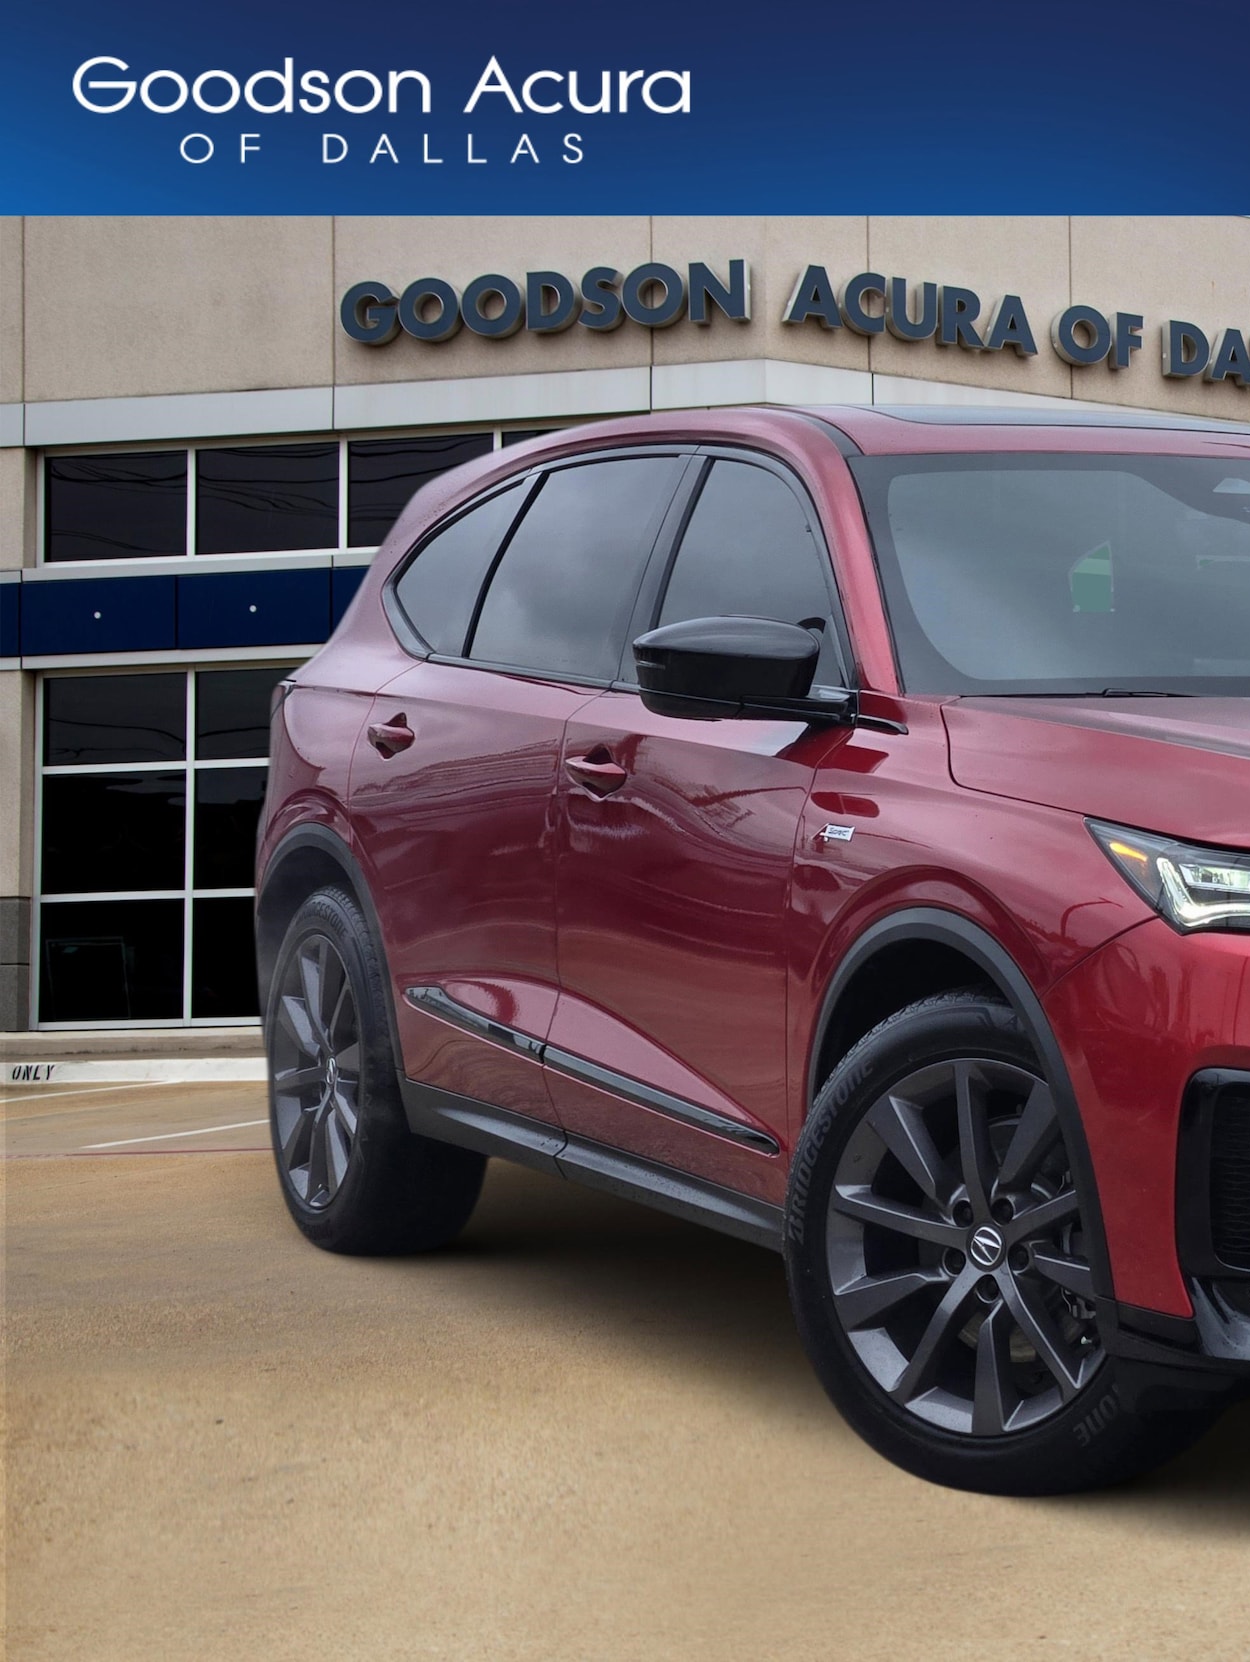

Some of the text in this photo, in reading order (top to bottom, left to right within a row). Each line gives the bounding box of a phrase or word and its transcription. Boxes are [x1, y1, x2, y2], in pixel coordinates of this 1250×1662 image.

[339, 258, 752, 348] GOODSON
[781, 264, 1039, 357] ACURA
[1051, 304, 1144, 371] OF
[12, 1064, 56, 1081] ONLY
